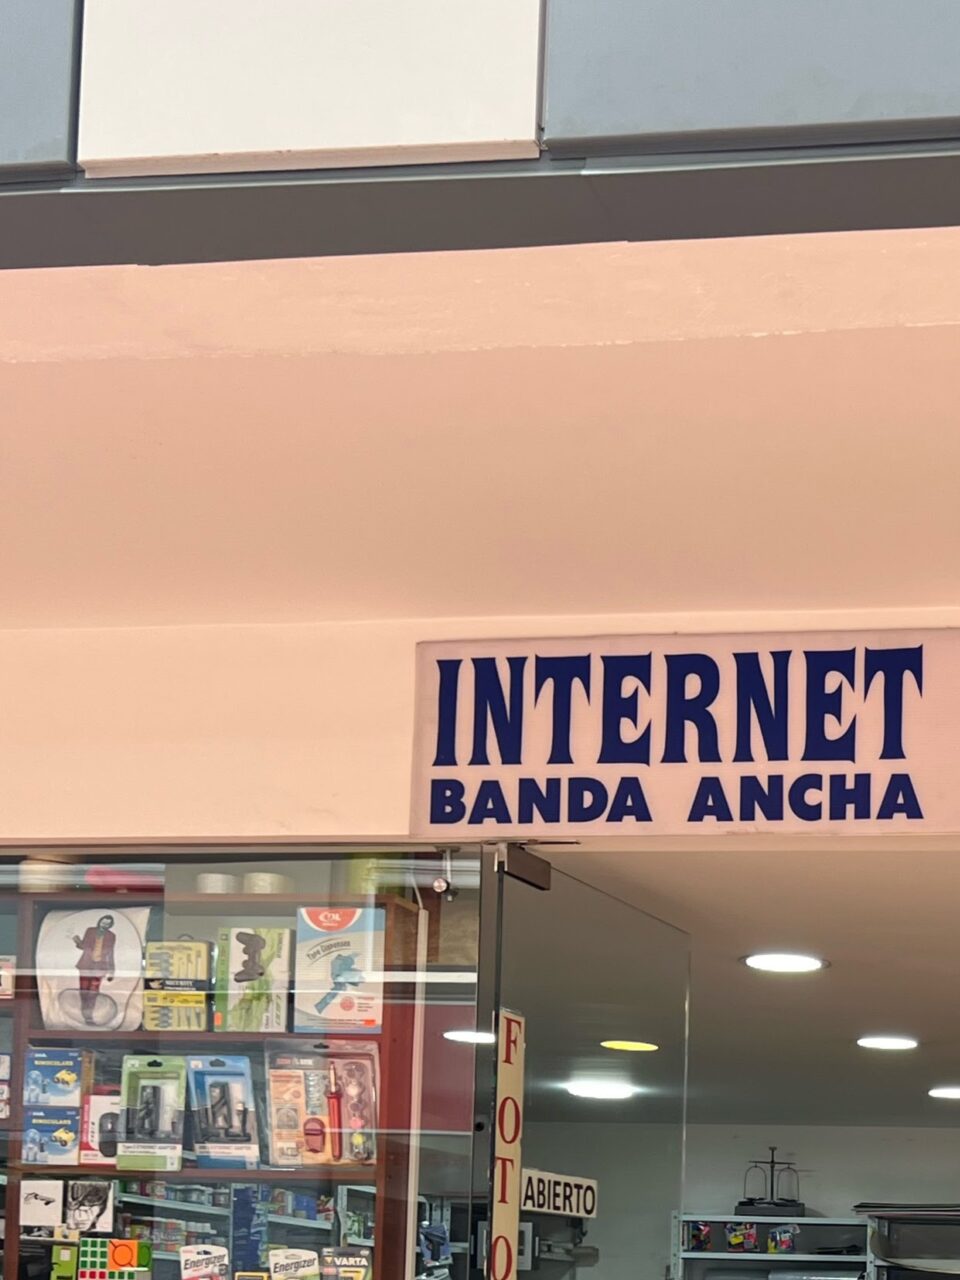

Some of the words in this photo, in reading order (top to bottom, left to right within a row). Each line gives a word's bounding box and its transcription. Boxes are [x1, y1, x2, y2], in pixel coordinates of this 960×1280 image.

[432, 643, 924, 767] INTERNET
[429, 776, 653, 824] BANDA
[687, 773, 924, 822] ANCHA
[522, 1175, 597, 1216] ABIERTO
[183, 1253, 227, 1271] Energizer
[273, 1257, 316, 1274] Energizer
[334, 1257, 368, 1266] VARTA
